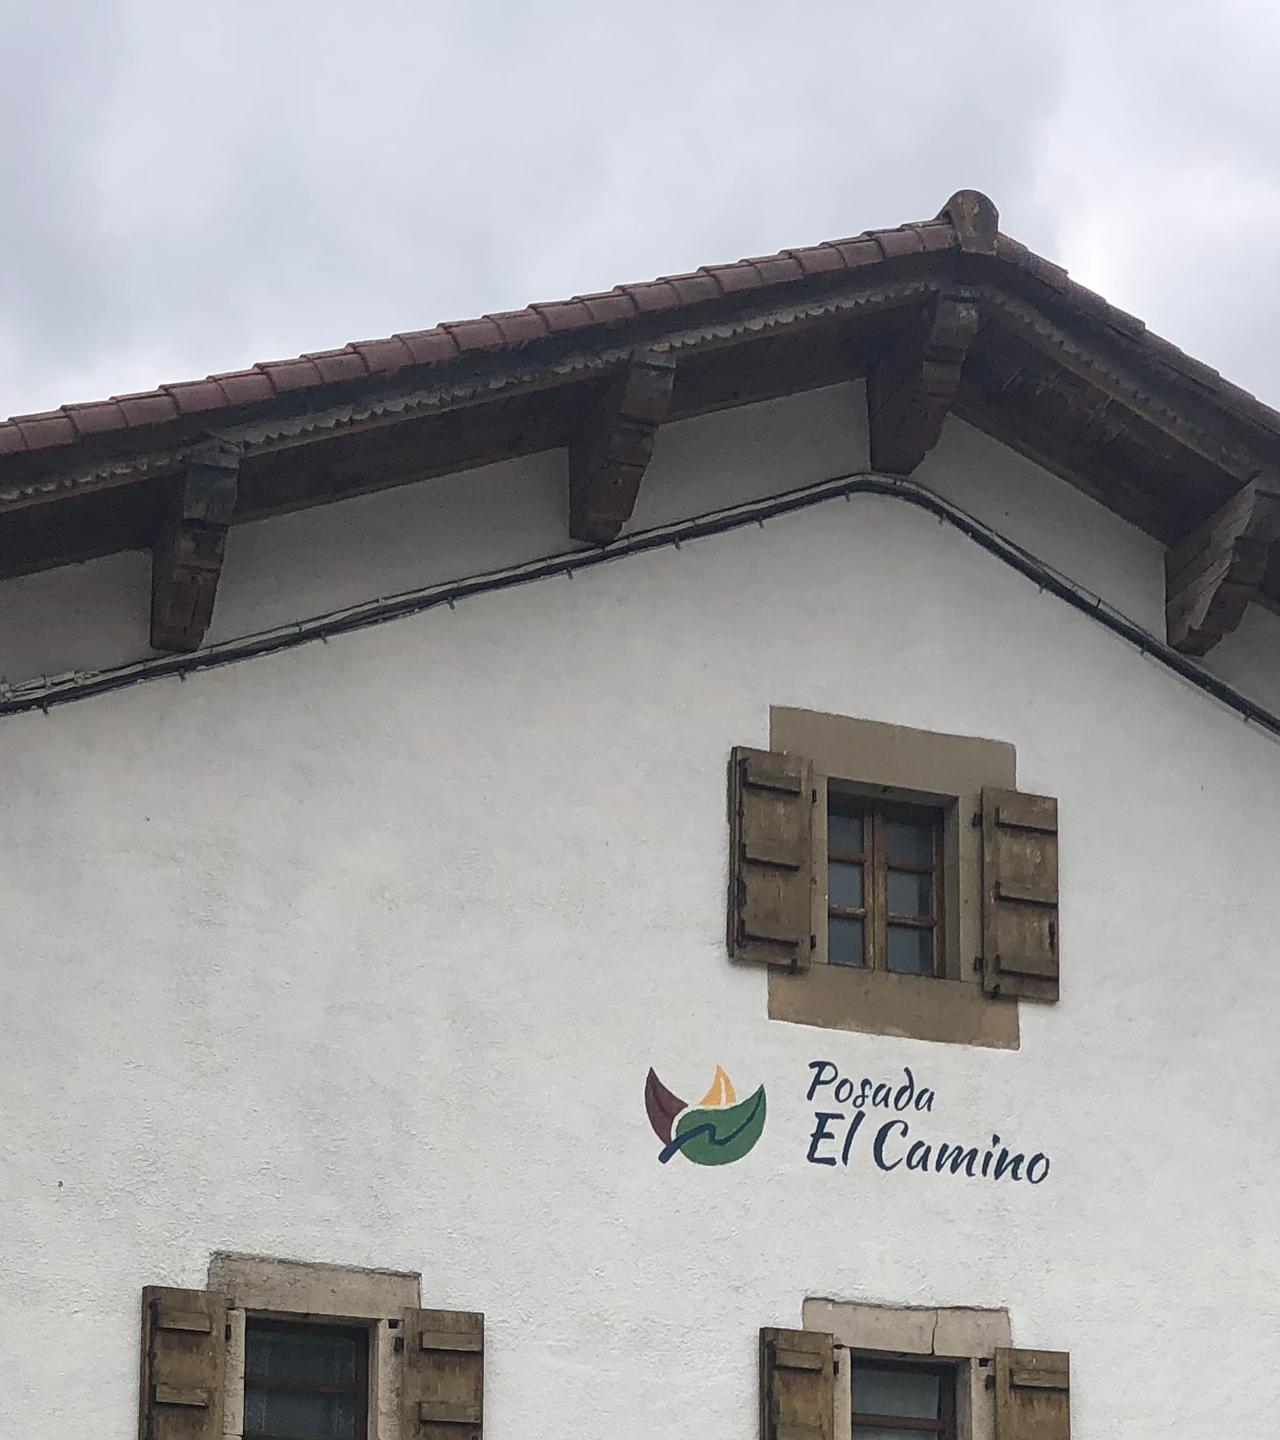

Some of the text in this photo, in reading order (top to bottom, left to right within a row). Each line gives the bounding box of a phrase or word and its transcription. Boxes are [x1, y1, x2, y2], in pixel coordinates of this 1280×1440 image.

[807, 1060, 935, 1112] Posada
[807, 1110, 1050, 1185] El Camino
